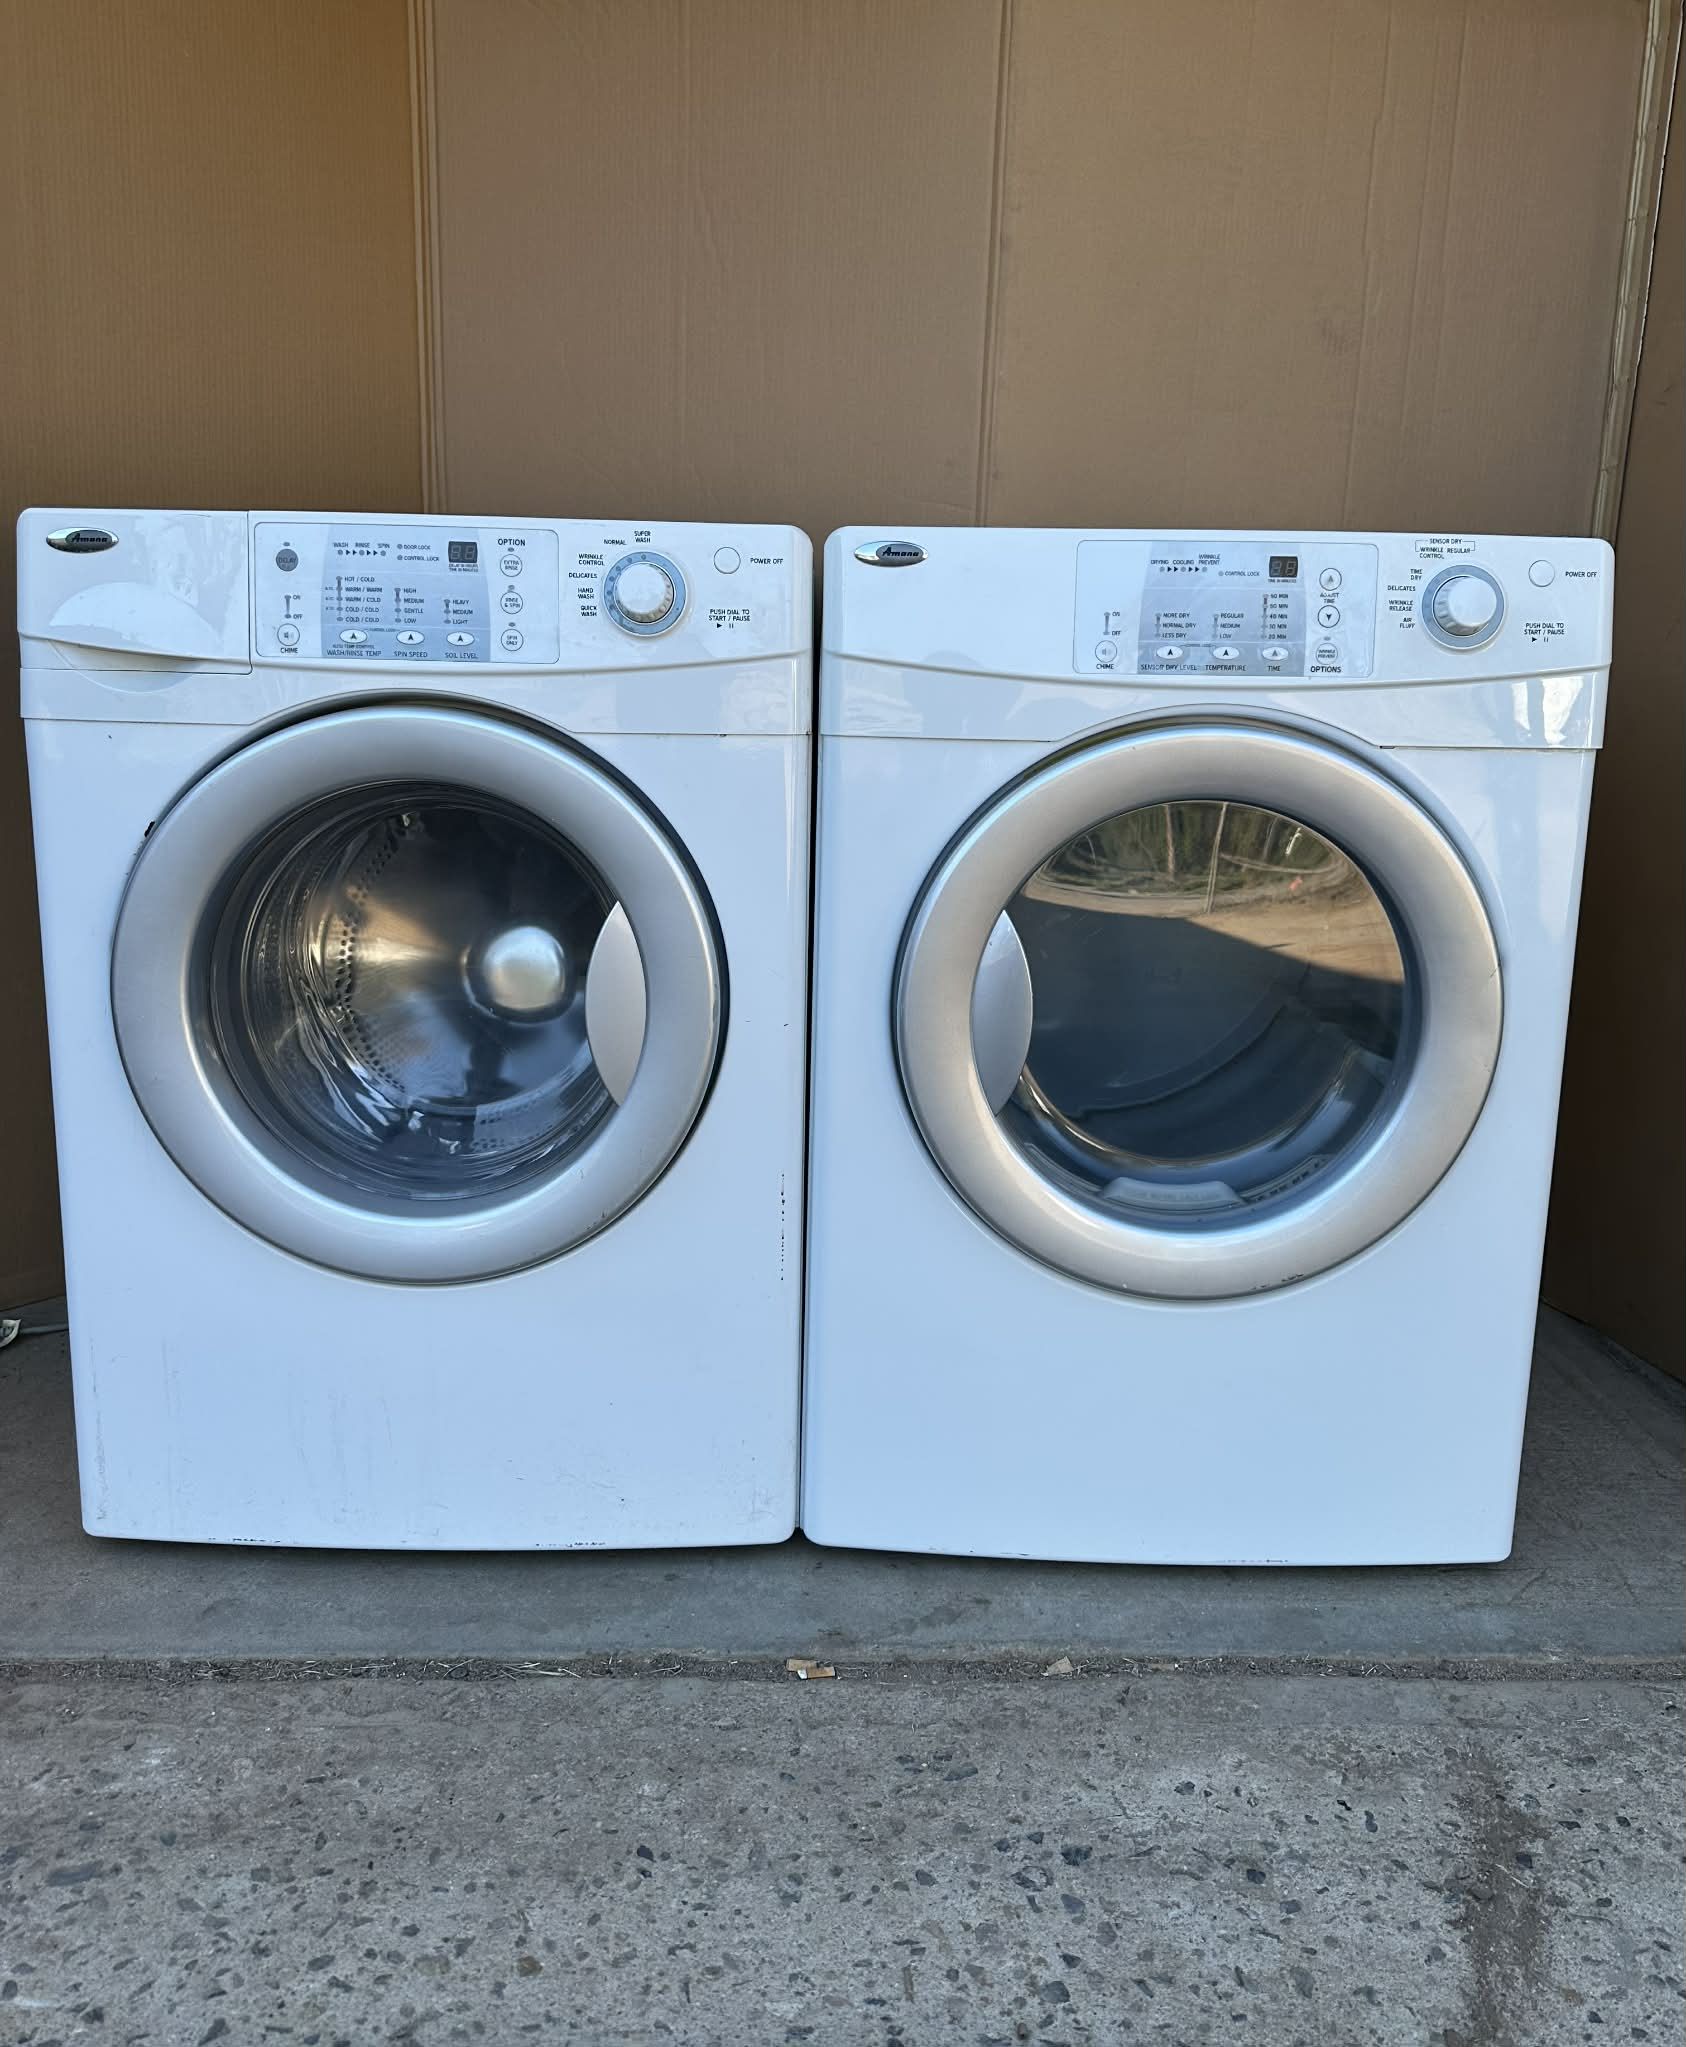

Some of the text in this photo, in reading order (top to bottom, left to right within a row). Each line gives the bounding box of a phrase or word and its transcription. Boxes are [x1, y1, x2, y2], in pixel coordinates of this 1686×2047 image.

[71, 533, 108, 543] Amana
[497, 539, 526, 547] OPTION
[882, 547, 919, 557] Amana
